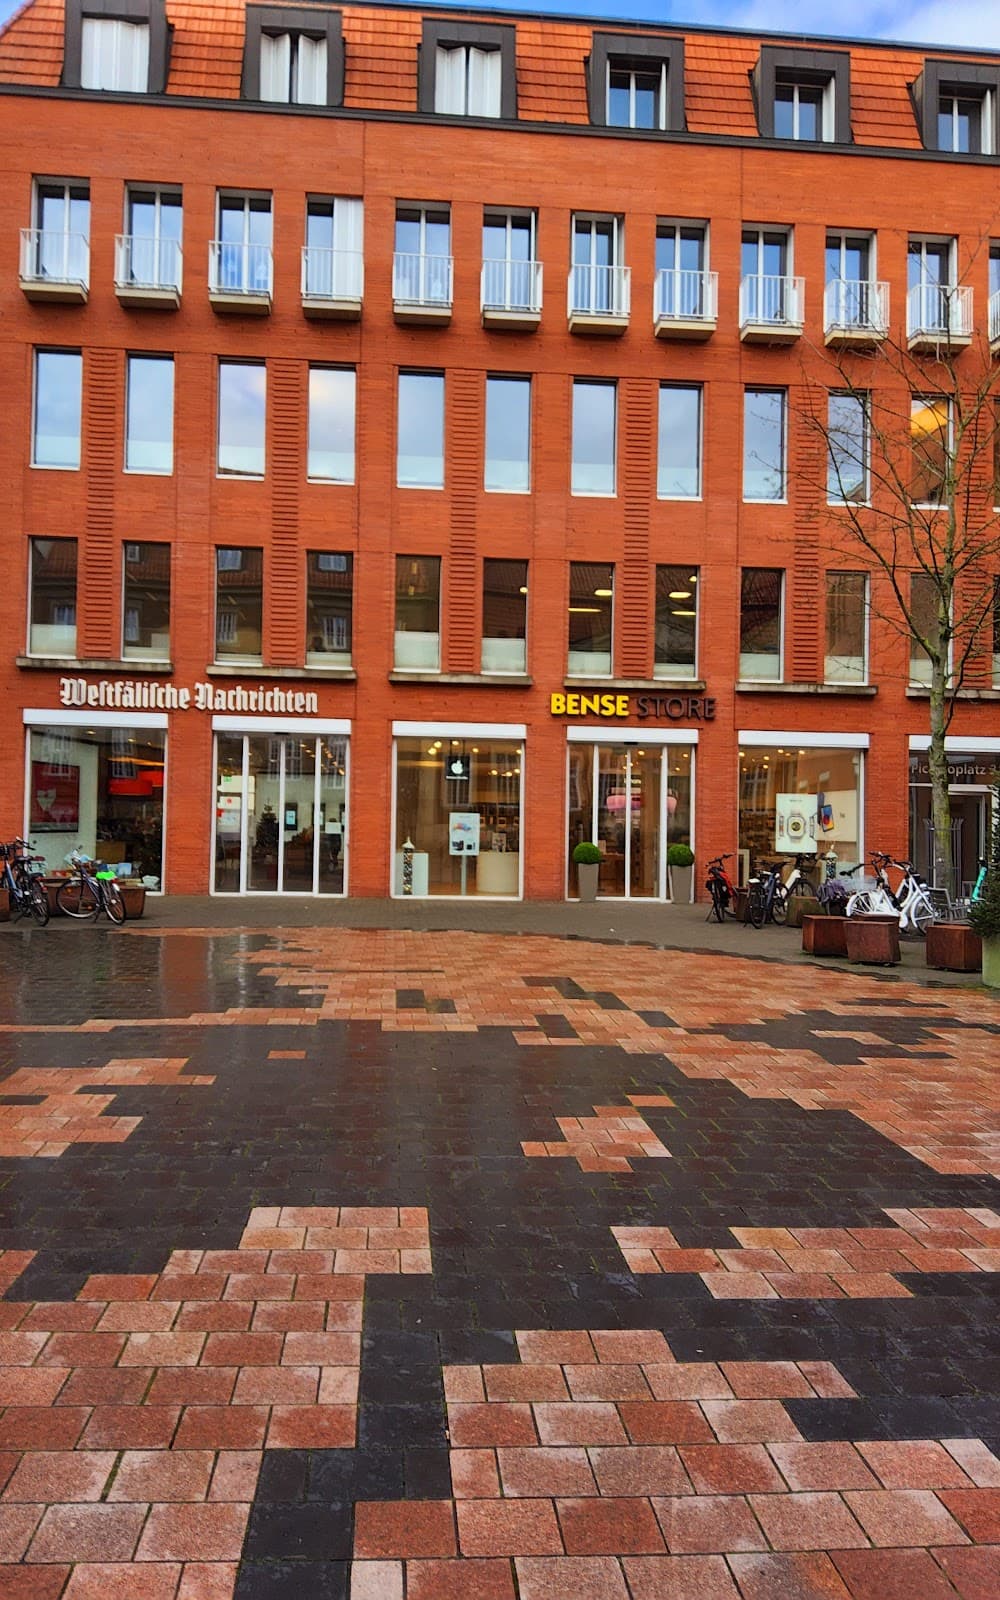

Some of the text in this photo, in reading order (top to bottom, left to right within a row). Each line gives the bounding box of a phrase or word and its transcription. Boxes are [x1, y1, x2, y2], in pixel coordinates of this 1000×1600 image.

[194, 682, 319, 713] Nachrichten
[550, 693, 716, 719] BENSE STORE
[911, 762, 986, 776] Picoplatz
